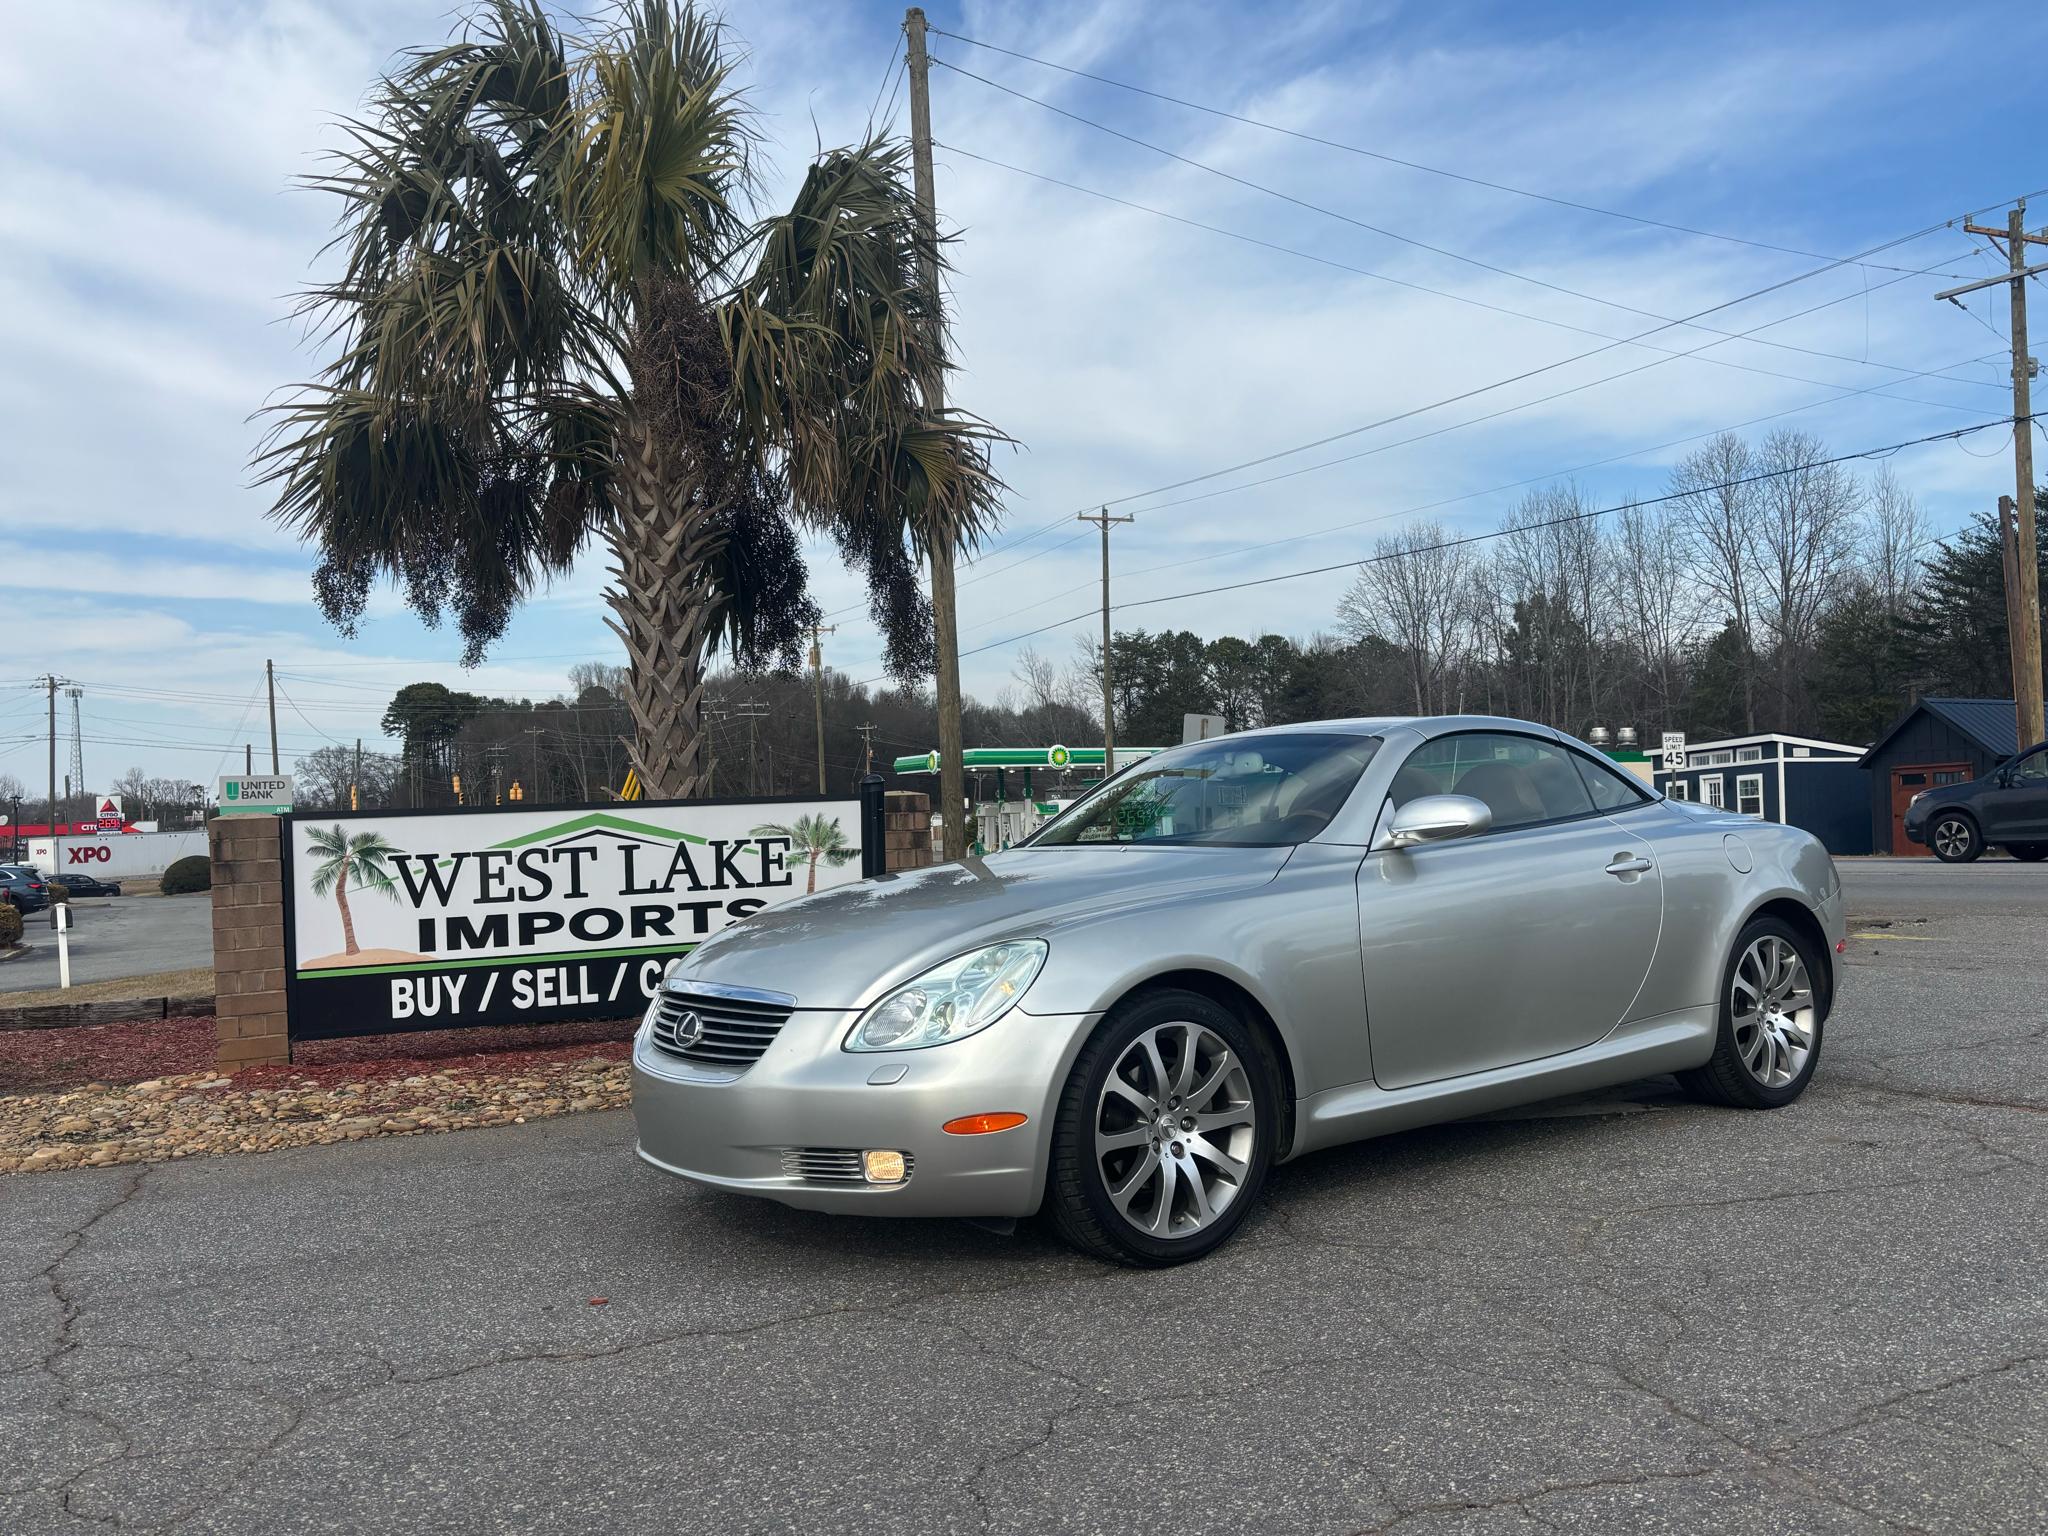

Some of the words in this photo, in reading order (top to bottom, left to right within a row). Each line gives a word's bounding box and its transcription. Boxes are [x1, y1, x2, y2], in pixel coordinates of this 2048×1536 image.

[1665, 752, 1684, 765] 45
[241, 781, 286, 790] UNITED
[241, 790, 273, 799] BANK
[68, 845, 111, 864] XPO
[388, 846, 598, 909] WEST
[617, 837, 793, 896] LAKE
[391, 974, 467, 1019] BUY
[478, 971, 500, 1013] /
[511, 965, 599, 1009] SELL
[608, 962, 628, 1002] /
[639, 957, 684, 999] C
